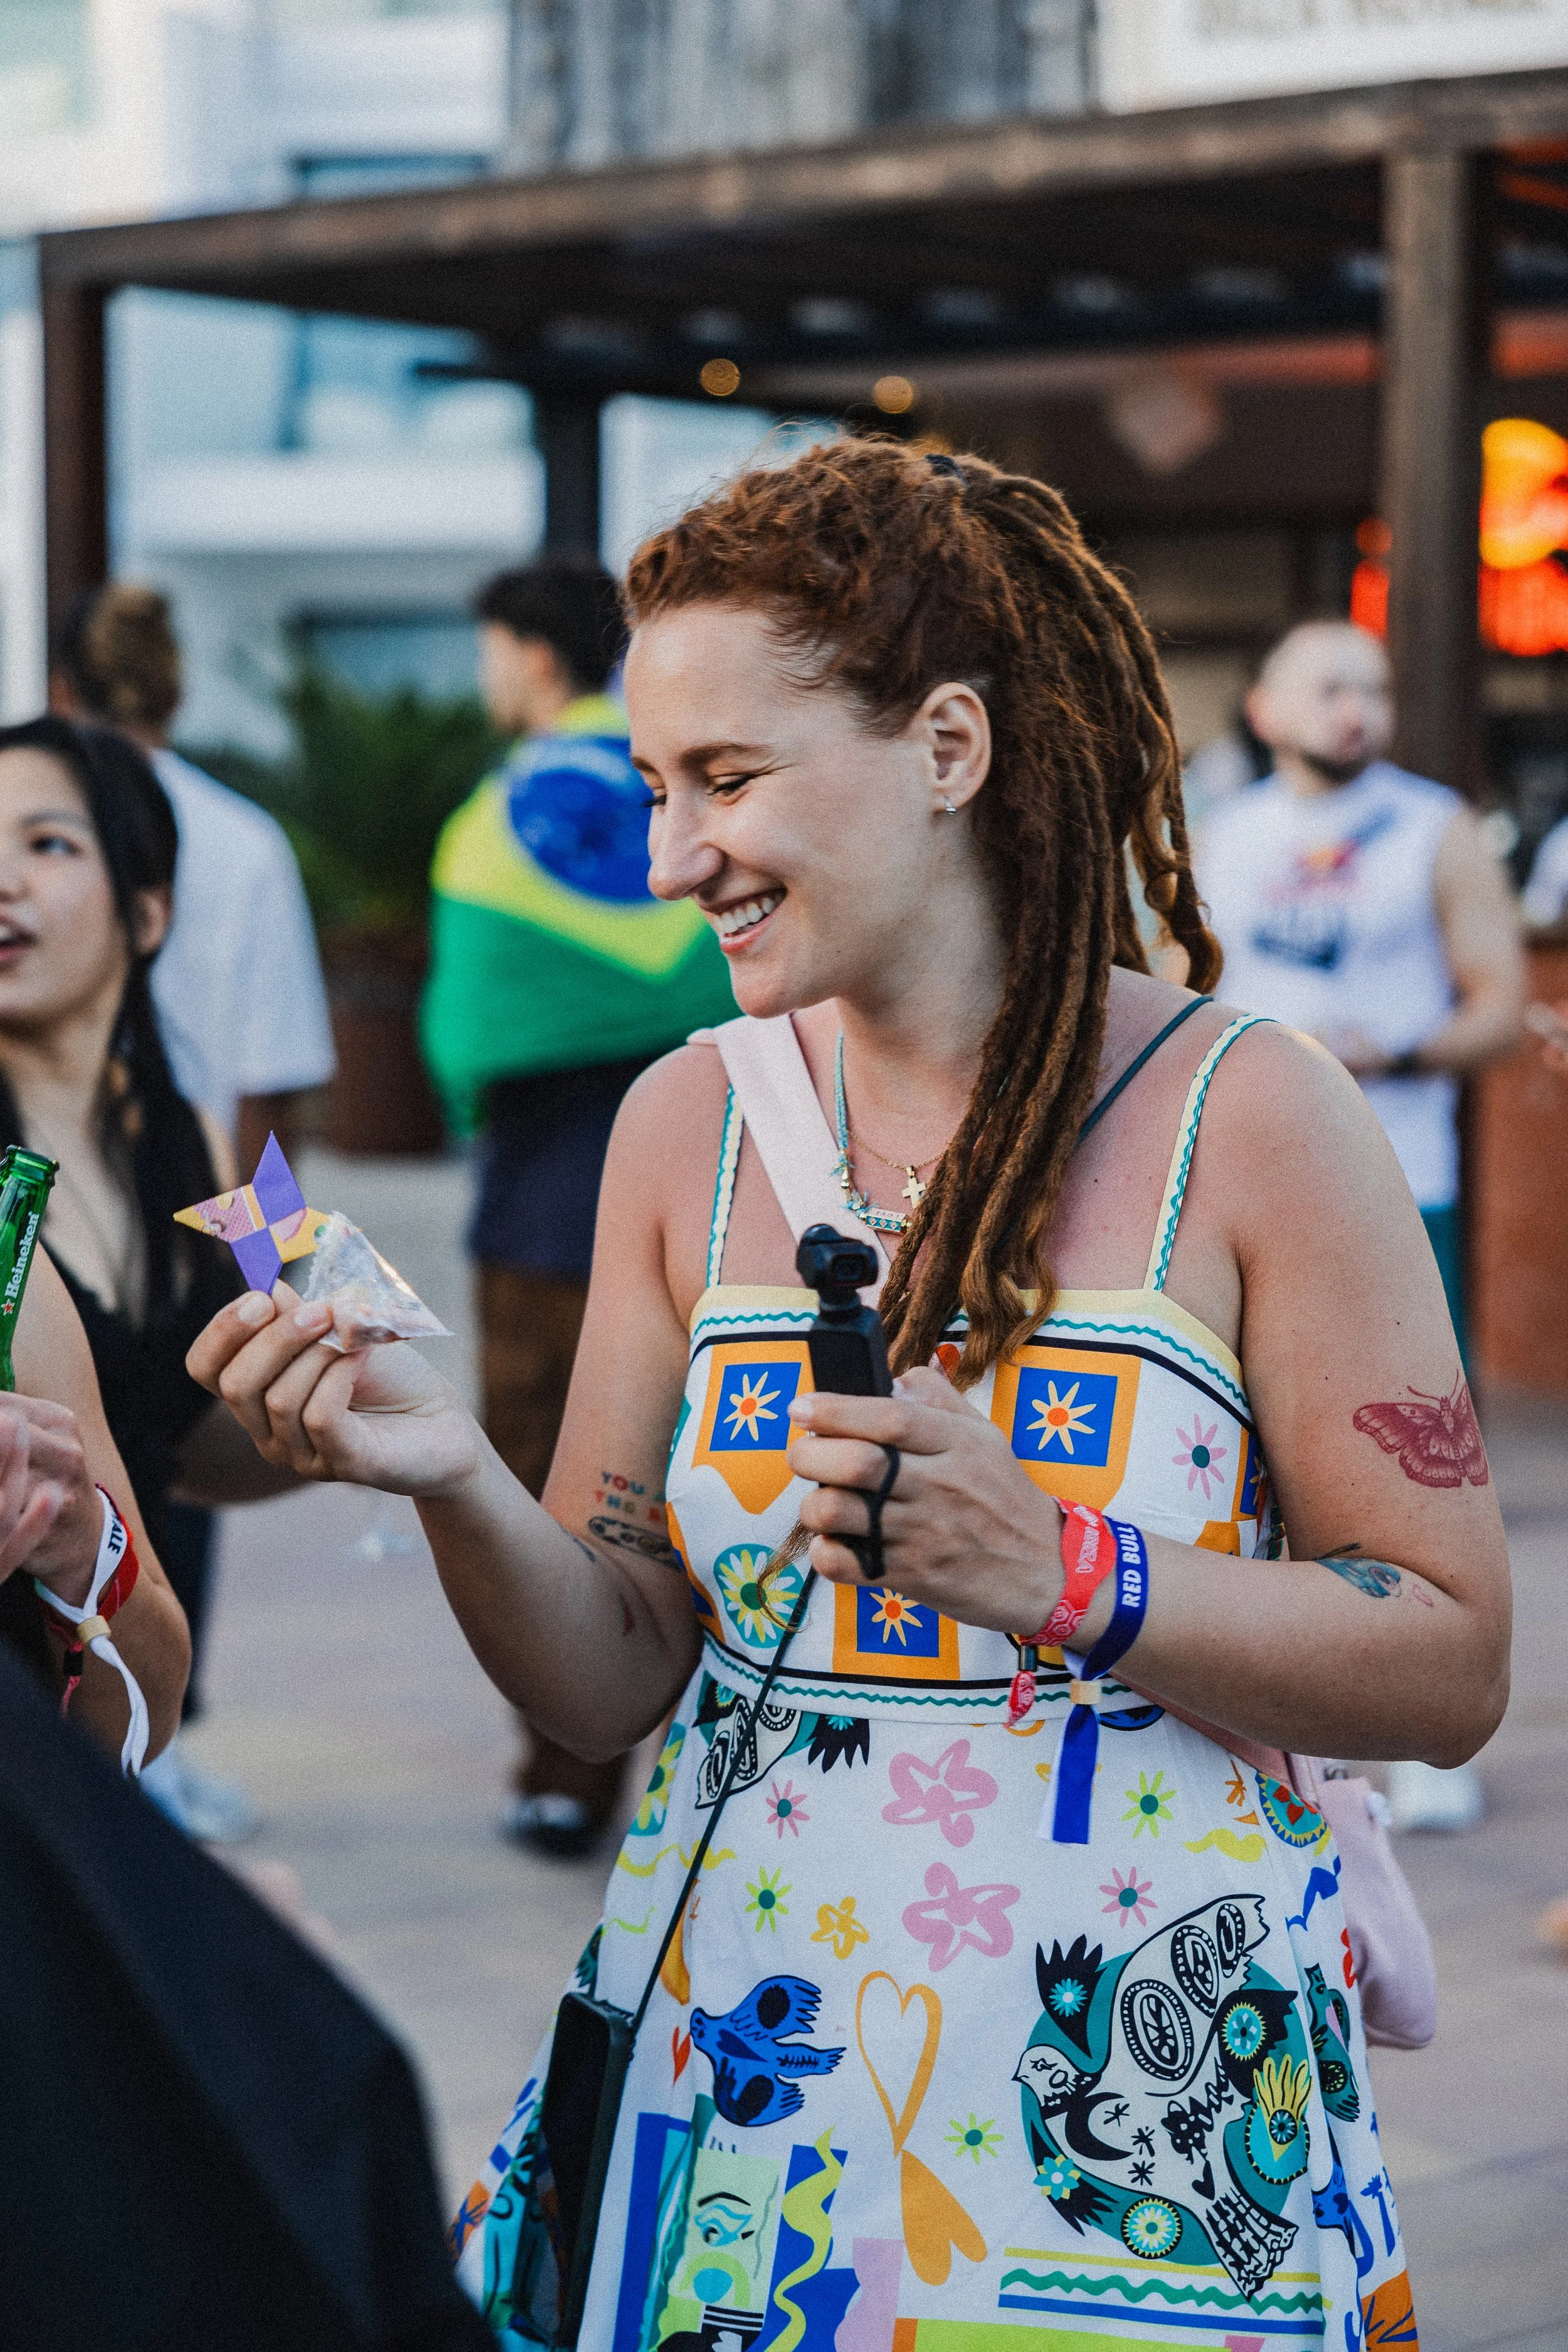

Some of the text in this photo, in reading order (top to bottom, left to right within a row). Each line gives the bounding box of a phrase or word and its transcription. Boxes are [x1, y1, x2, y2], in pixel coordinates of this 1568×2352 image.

[4, 1212, 40, 1299] Heineken
[601, 1470, 646, 1496] YOU
[107, 1514, 123, 1554] ALE
[1117, 1527, 1142, 1608] RED BULL
